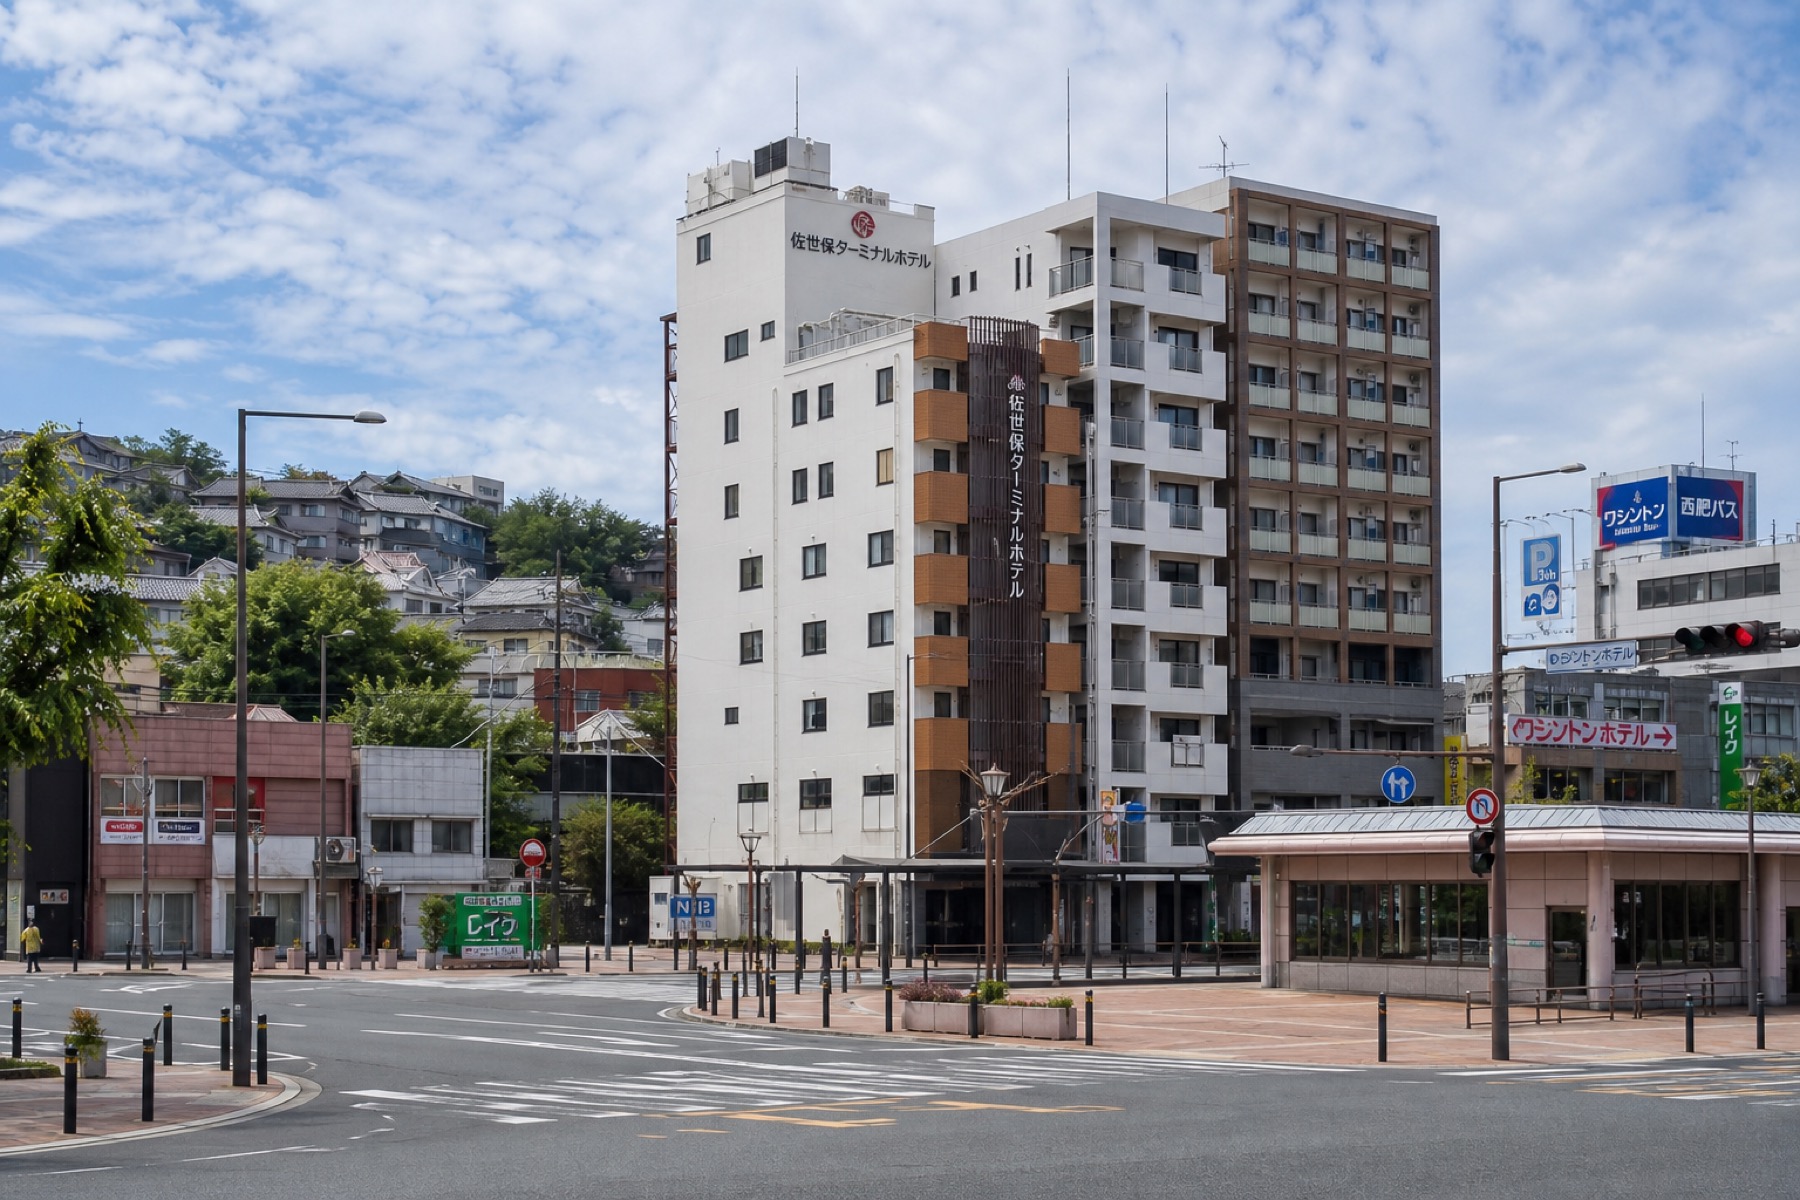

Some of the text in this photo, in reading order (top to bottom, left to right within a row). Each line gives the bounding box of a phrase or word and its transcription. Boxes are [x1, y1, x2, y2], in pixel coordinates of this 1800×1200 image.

[790, 231, 932, 269] 佐世保ターミナルホテル
[1008, 393, 1025, 599] 佐世保ターミナルホテル
[1603, 503, 1665, 527] ワシントン
[1680, 496, 1739, 519] 西肥バス
[1724, 709, 1739, 756] レイク
